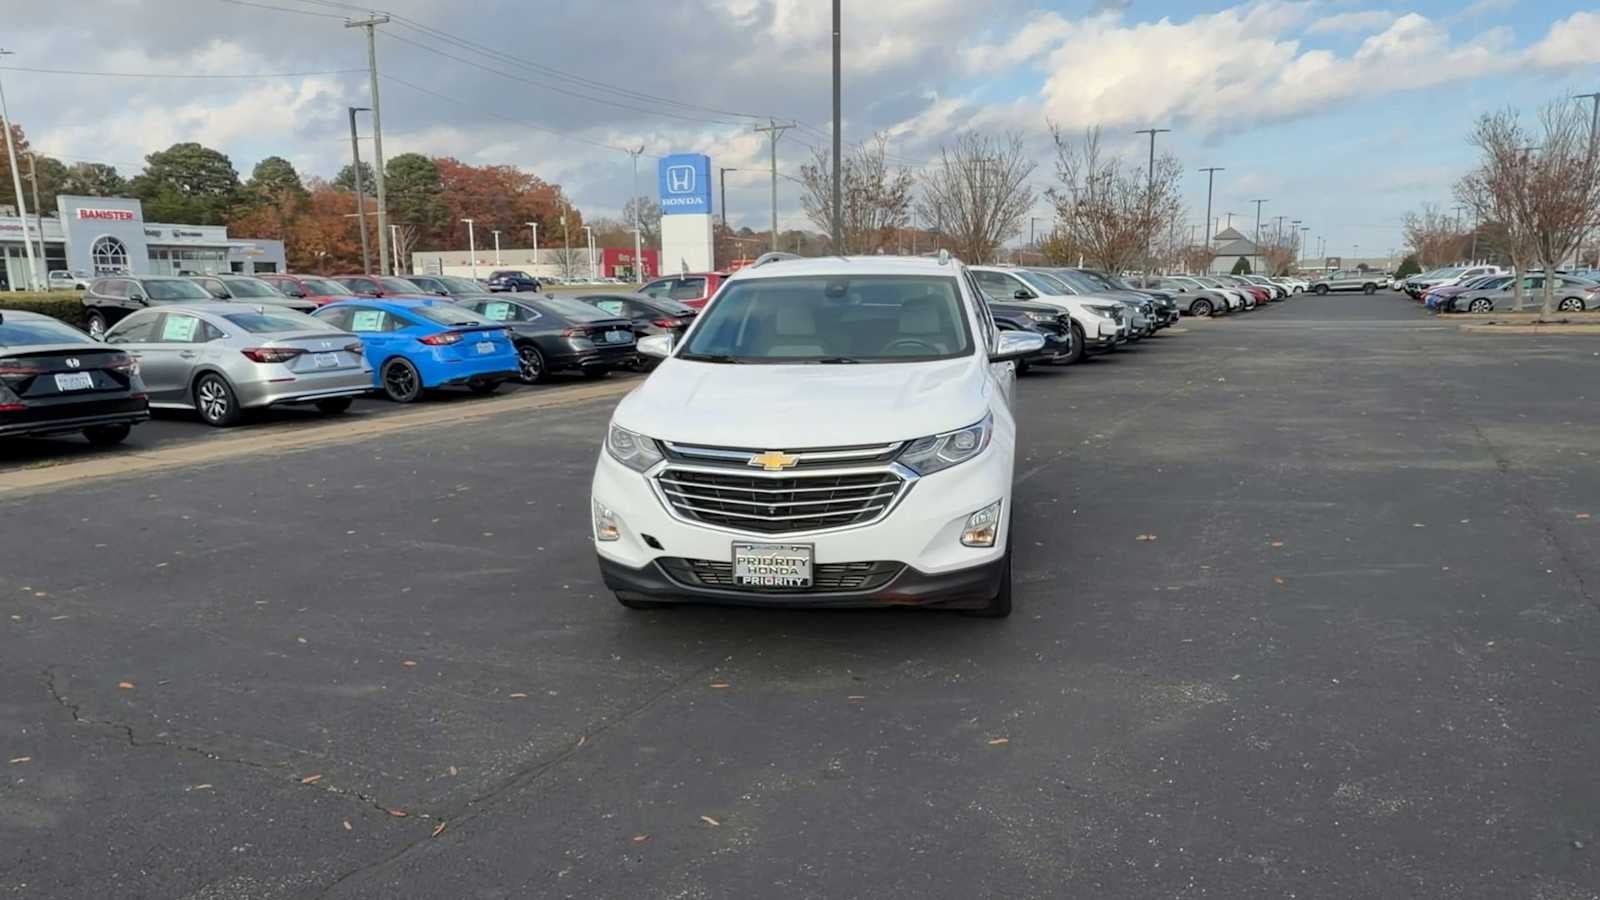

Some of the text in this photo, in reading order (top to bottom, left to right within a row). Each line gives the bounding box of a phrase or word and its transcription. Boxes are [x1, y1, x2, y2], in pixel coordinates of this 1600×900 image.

[662, 197, 703, 205] HONDA
[80, 209, 133, 219] BANISTER
[737, 556, 808, 566] PRIORITY
[748, 566, 799, 575] HONDA
[743, 576, 803, 586] PRIORITY
